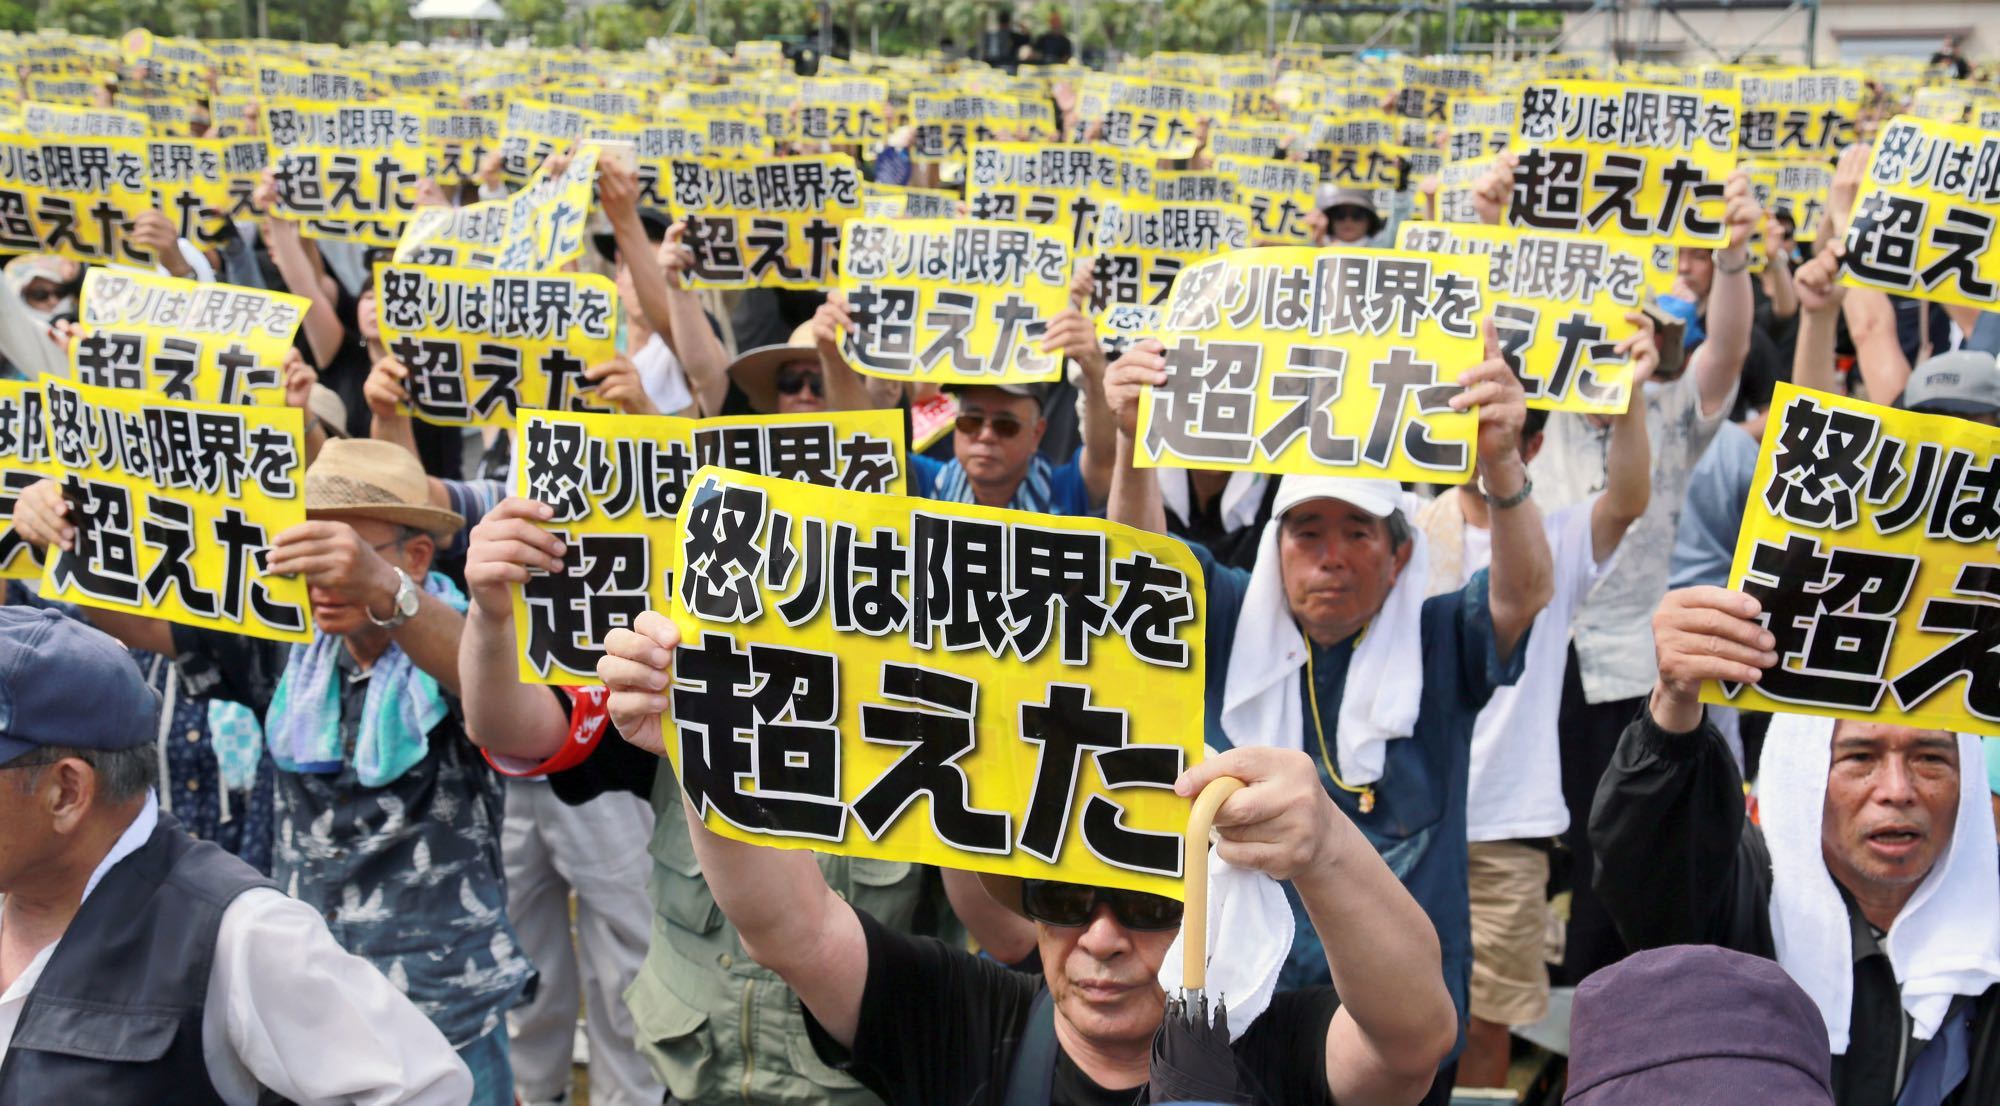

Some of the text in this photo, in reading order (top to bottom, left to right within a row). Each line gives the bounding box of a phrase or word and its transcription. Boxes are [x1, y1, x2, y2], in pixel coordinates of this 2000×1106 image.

[268, 107, 423, 149] 怒りは限界を
[802, 107, 882, 139] 超えた
[1521, 85, 1735, 151] 怒りは限界を
[1739, 109, 1857, 152] 超えた
[1740, 77, 1860, 105] 怒りは限界を
[271, 155, 421, 214] 超えた
[670, 160, 860, 211] 怒りは限界を
[972, 148, 1117, 189] 怒りは限界を
[1507, 147, 1729, 238] 超えた
[680, 213, 842, 282] 超えた
[848, 223, 1066, 288] 怒りは限界を
[1838, 190, 1996, 303] 超え
[382, 268, 612, 343] 怒りは限界を
[843, 283, 1057, 378] 超えた
[1163, 256, 1483, 340] 怒りは限界を
[388, 335, 616, 422] 超えた
[1141, 336, 1472, 473] 超えた
[47, 382, 299, 499] 怒りは限界を
[1761, 393, 2000, 544] 怒りは
[52, 471, 306, 633] 超えた
[679, 475, 1195, 670] 怒りは限界を
[671, 630, 1186, 878] 超えた
